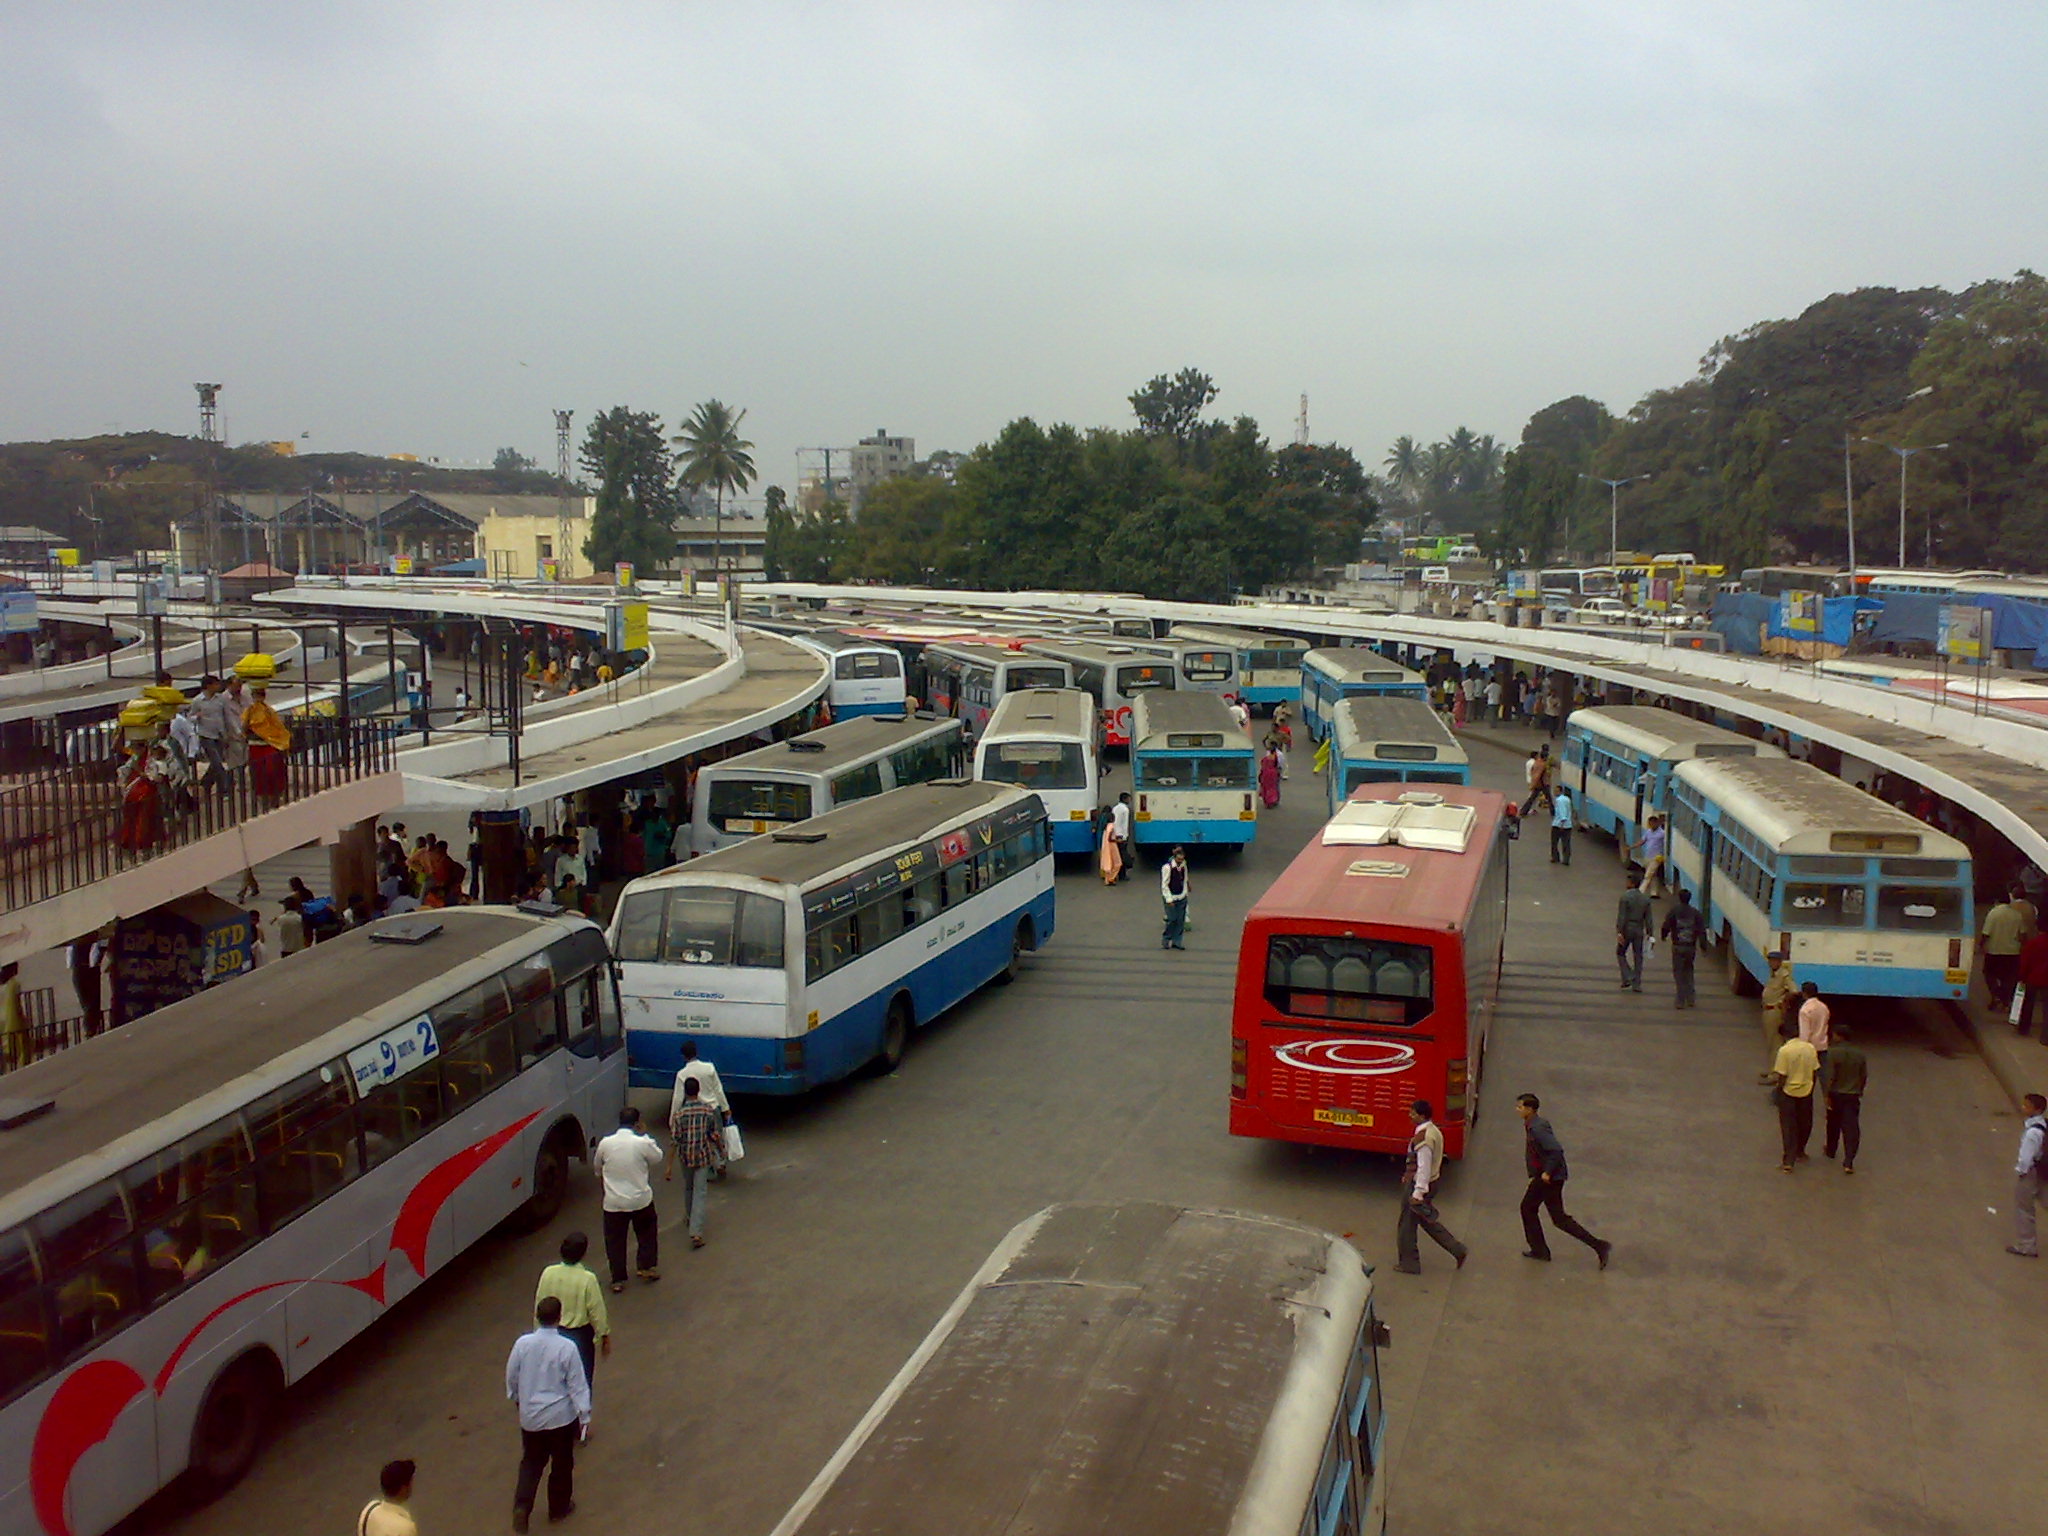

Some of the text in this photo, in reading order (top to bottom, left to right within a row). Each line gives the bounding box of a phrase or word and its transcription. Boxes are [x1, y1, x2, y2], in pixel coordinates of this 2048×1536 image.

[204, 923, 246, 950] STD
[214, 949, 243, 975] SD
[416, 1021, 437, 1057] 2
